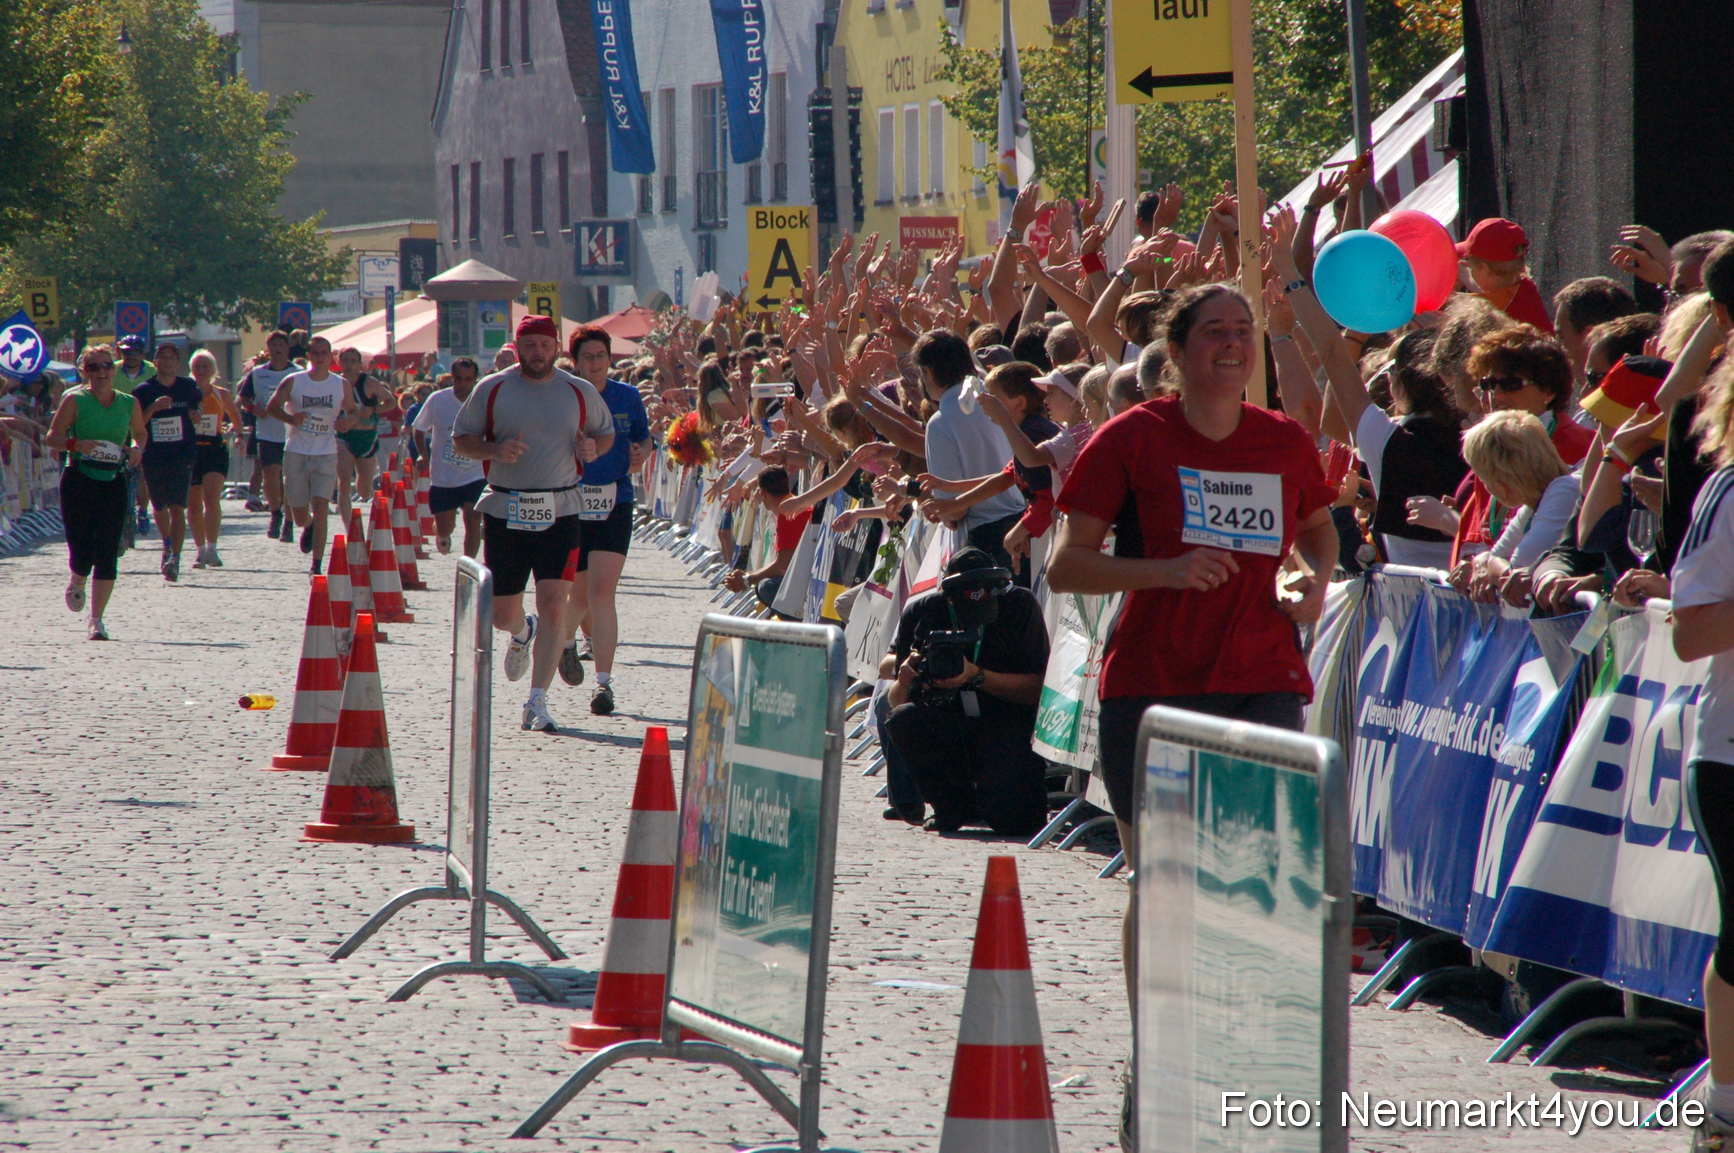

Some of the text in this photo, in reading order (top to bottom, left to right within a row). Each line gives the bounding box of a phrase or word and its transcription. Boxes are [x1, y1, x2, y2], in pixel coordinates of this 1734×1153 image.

[885, 55, 916, 93] HOTEL
[748, 67, 763, 115] K&L
[755, 210, 810, 229] Block
[763, 237, 802, 288] A
[25, 280, 51, 289] Block
[531, 284, 557, 293] Block
[31, 292, 50, 317] B
[536, 297, 554, 317] B
[160, 427, 180, 436] 2281
[309, 422, 329, 432] 3100
[583, 486, 602, 495] Sonja
[1203, 479, 1253, 495] Sabine
[518, 497, 545, 505] Norbert
[584, 498, 613, 511] 3241
[1188, 494, 1199, 506] D
[519, 509, 552, 521] 3256
[1208, 504, 1275, 531] 2420
